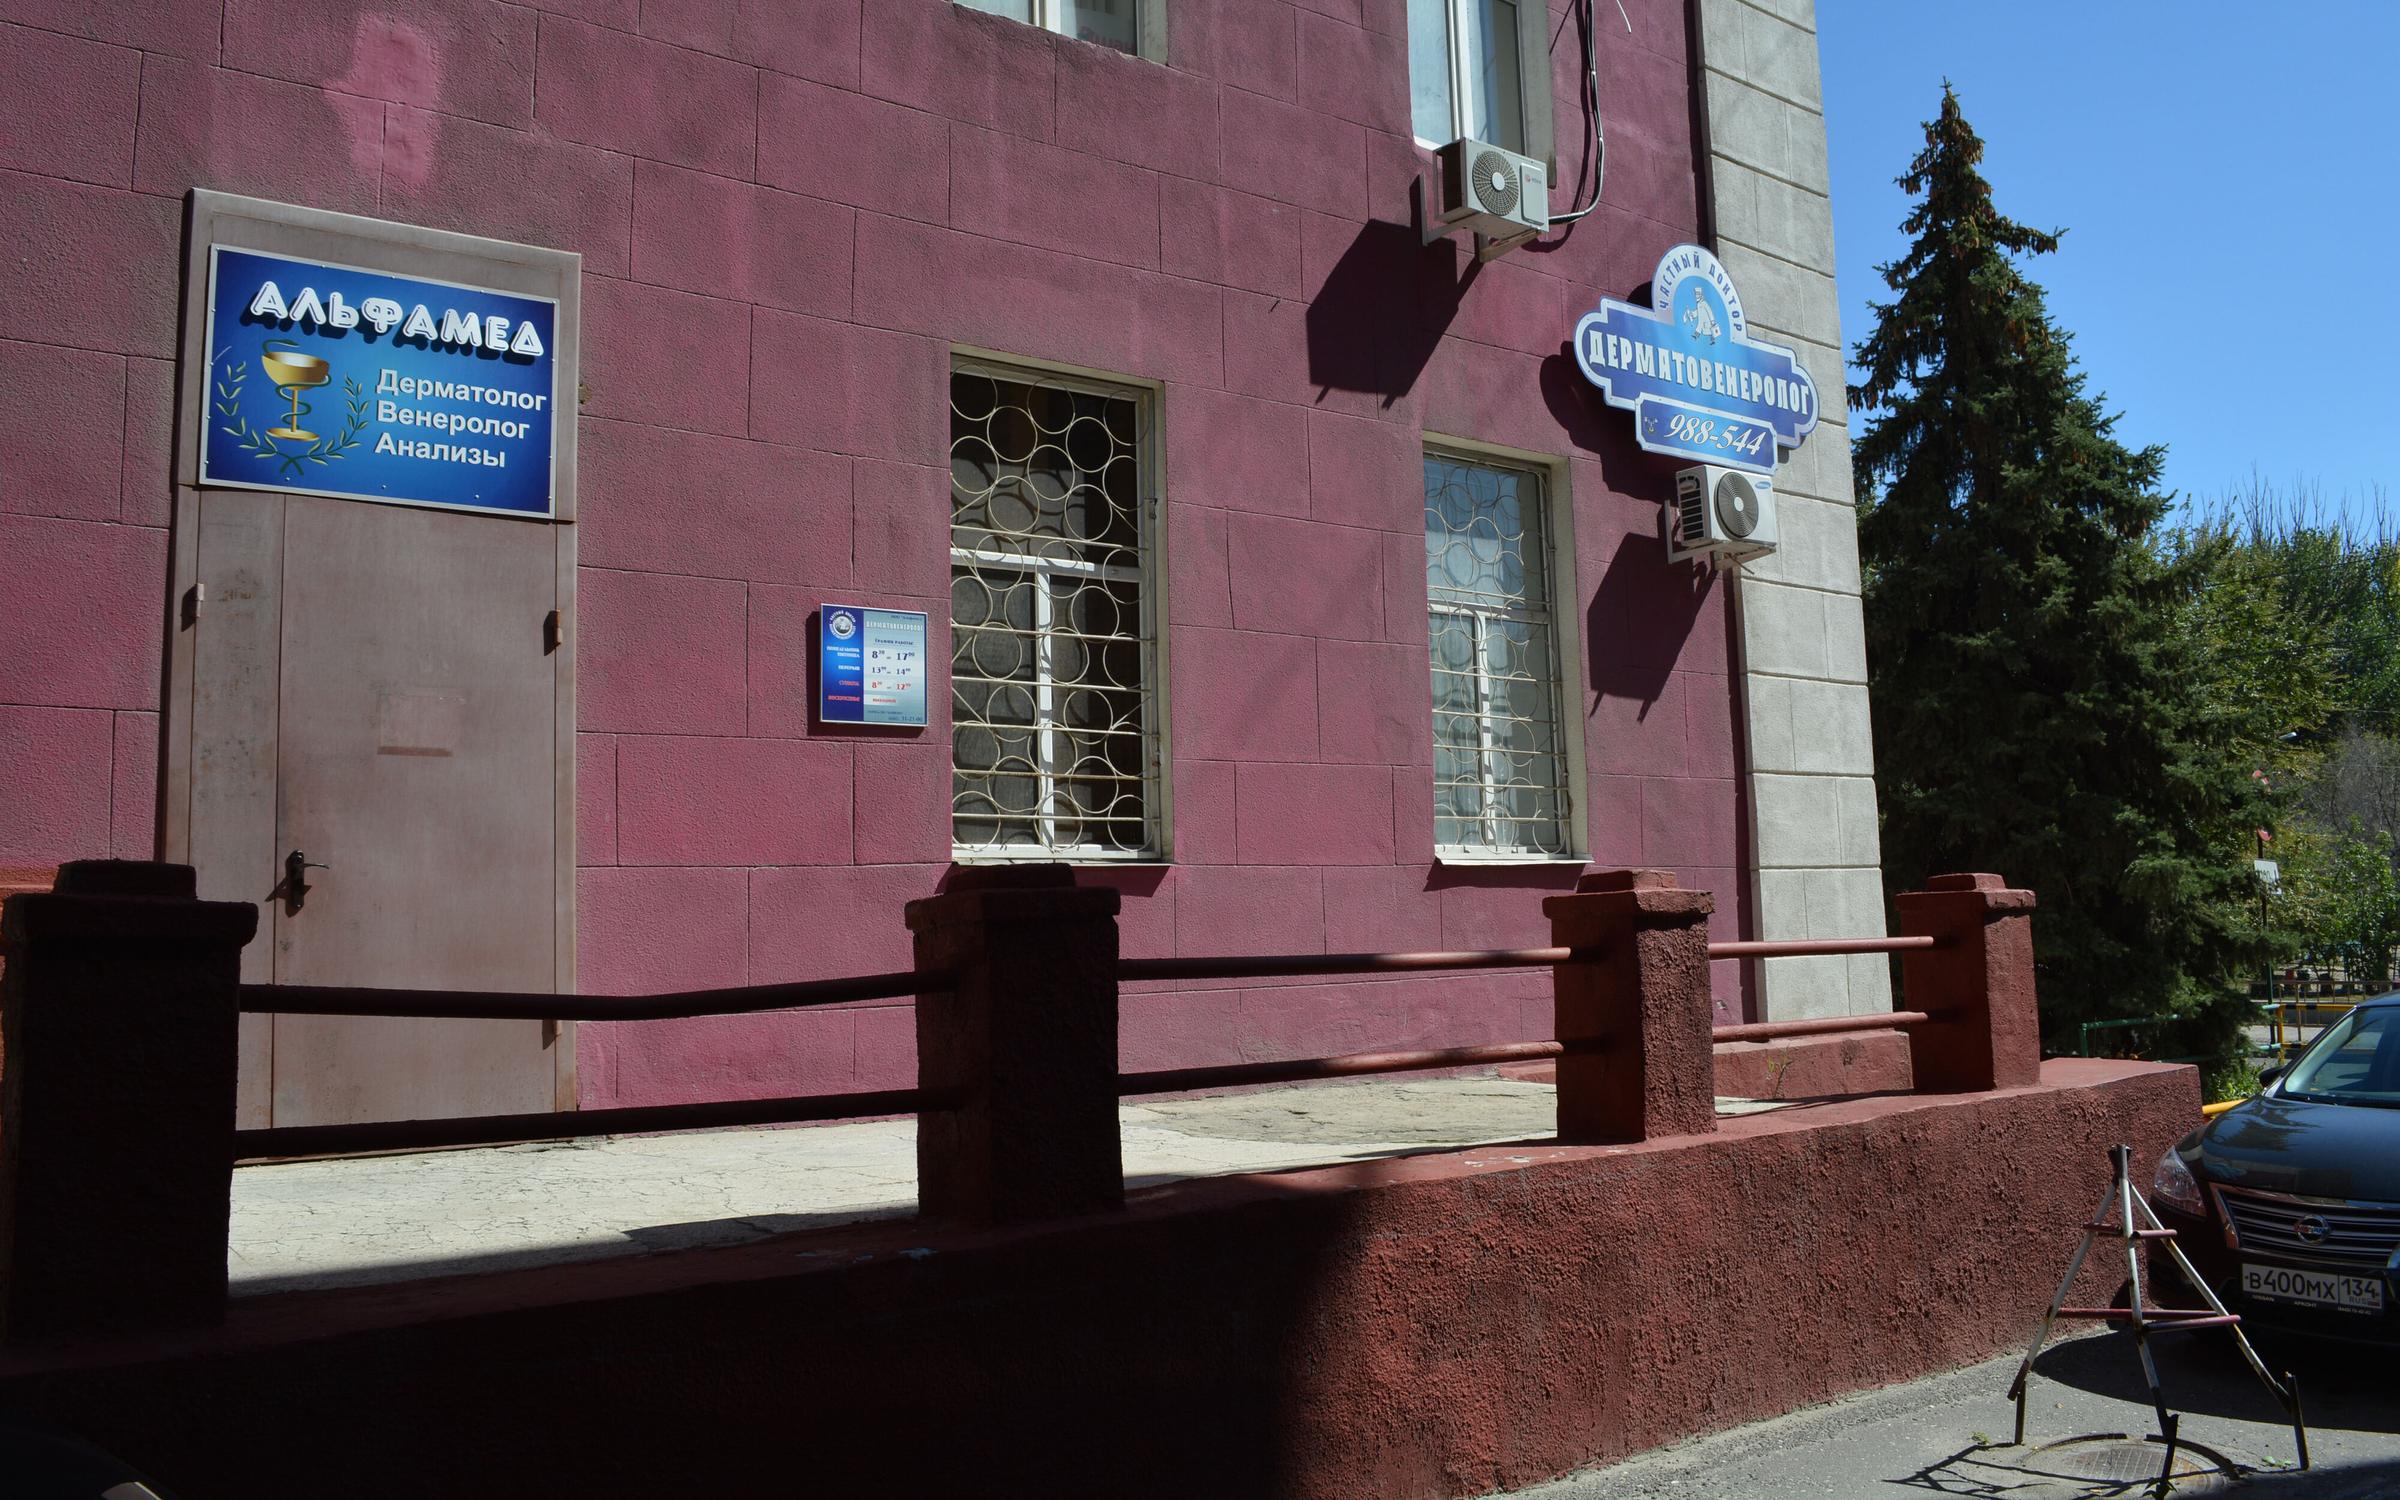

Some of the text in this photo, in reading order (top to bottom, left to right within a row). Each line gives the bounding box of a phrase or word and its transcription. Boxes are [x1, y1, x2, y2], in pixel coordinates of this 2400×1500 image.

[1659, 251, 1742, 332] ЧАСТНЫЙ ДОКТОР
[250, 280, 545, 357] АЛЬФАМЕД
[376, 368, 547, 412] Дерматолог
[376, 399, 530, 440] Венеролог
[1664, 414, 1767, 456] 988-544
[374, 432, 506, 468] Анализы
[2341, 1278, 2377, 1299] 134
